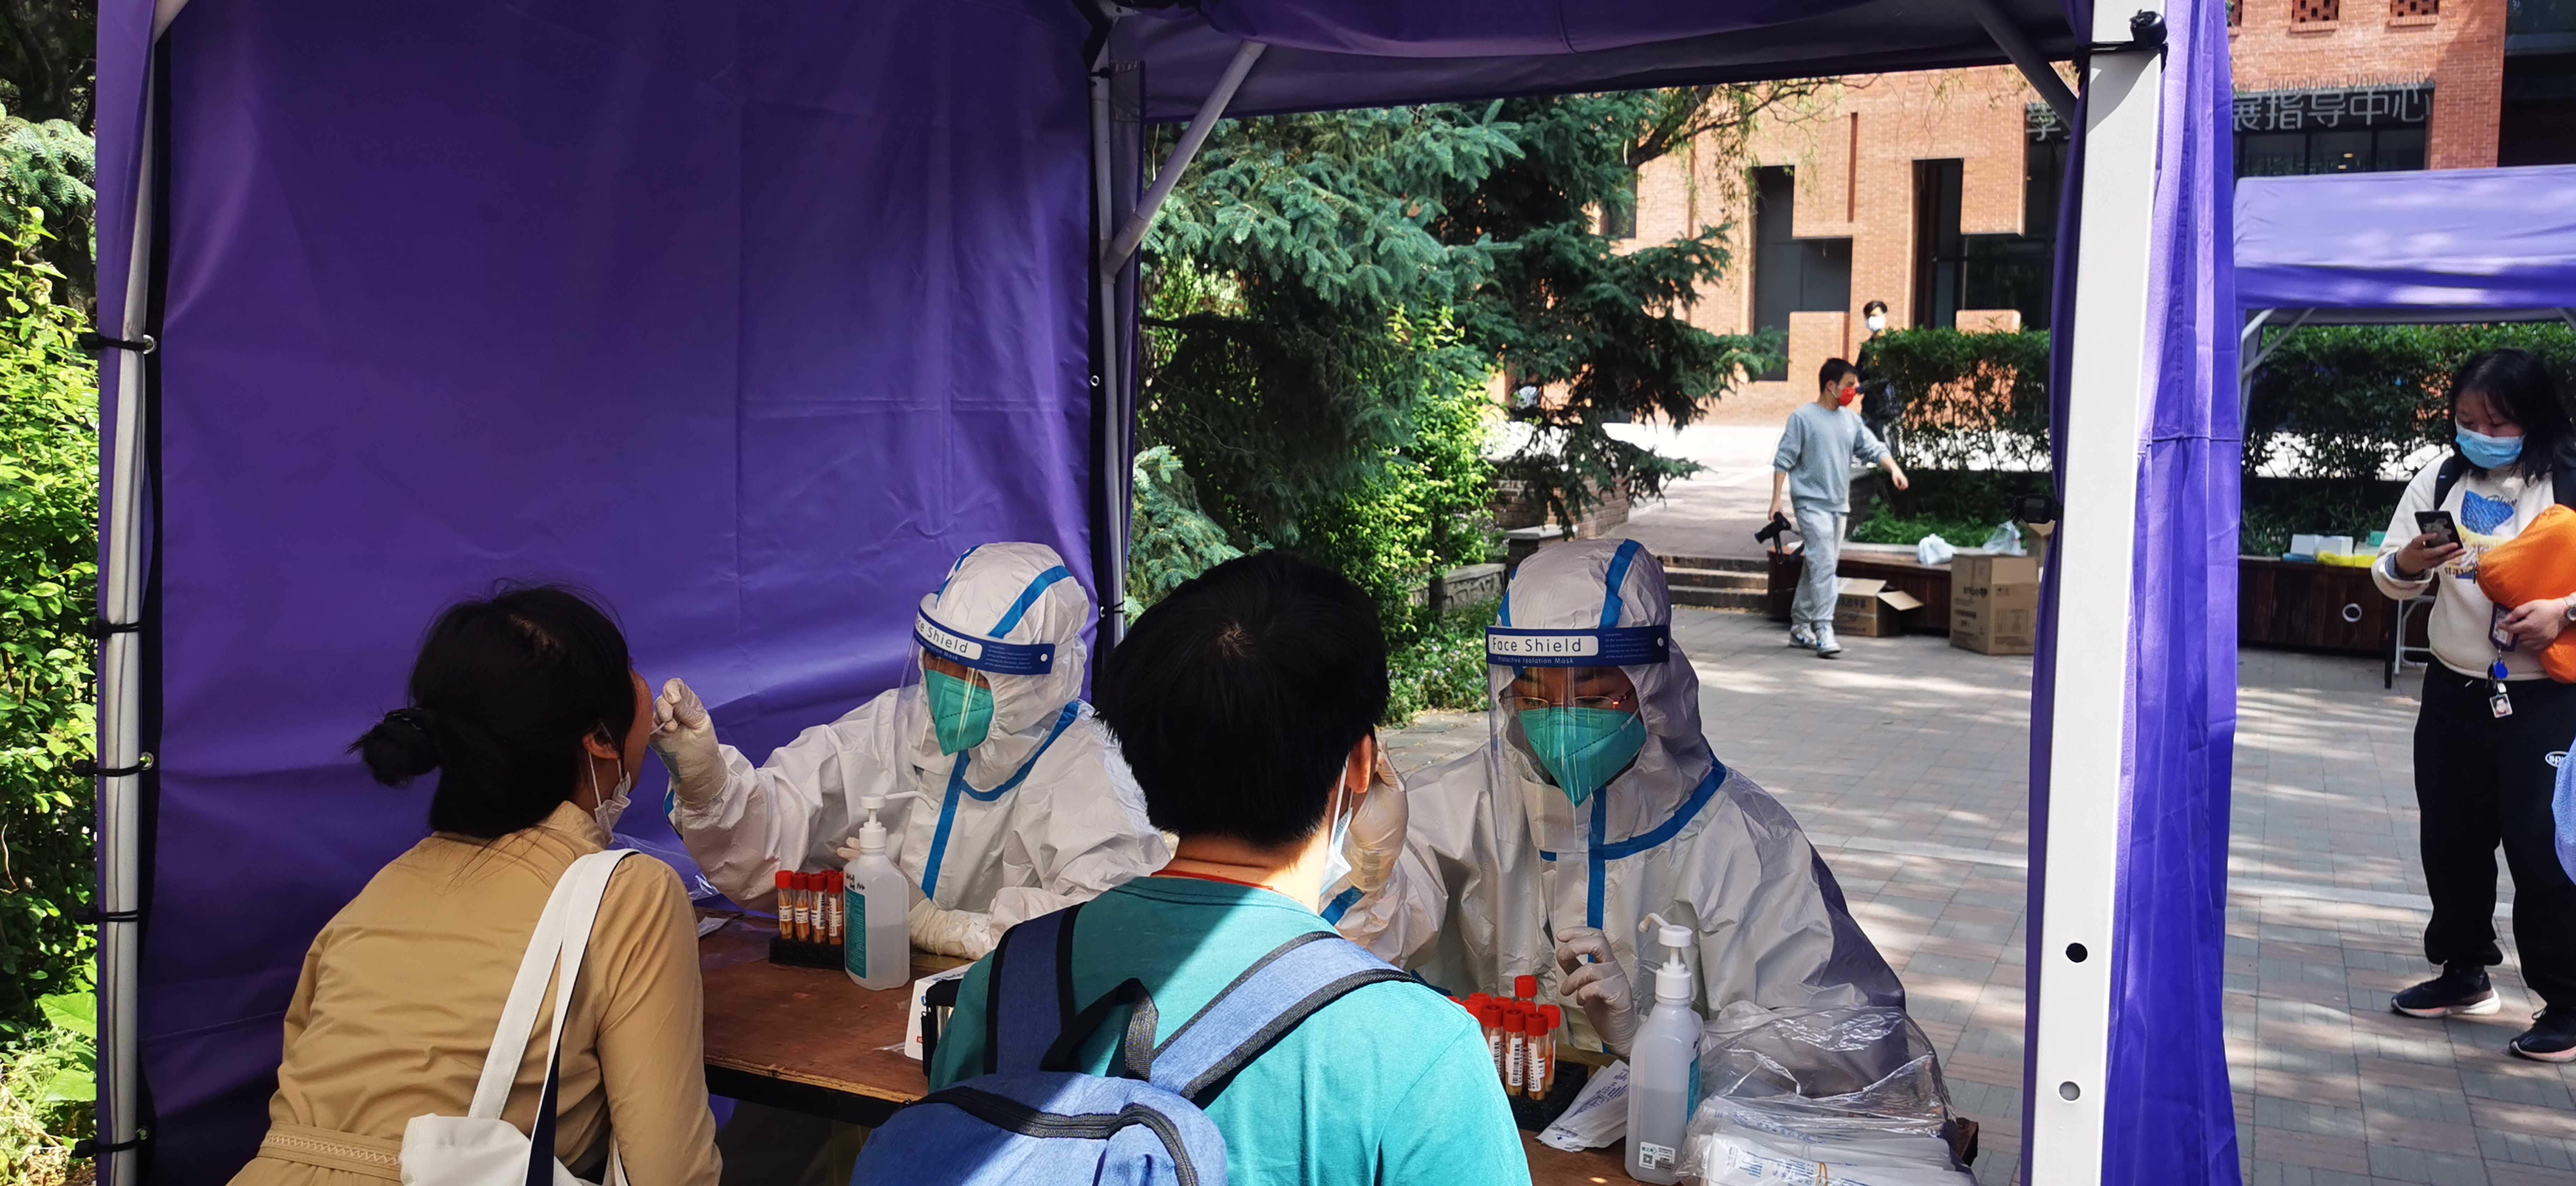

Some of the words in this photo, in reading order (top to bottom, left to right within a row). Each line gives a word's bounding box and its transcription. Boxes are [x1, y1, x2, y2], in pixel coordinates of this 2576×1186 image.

[2347, 71, 2432, 88] University
[2233, 88, 2430, 132] 展指导中心
[927, 627, 968, 653] Shield
[1493, 637, 1517, 652] Face
[1525, 637, 1581, 652] Shield
